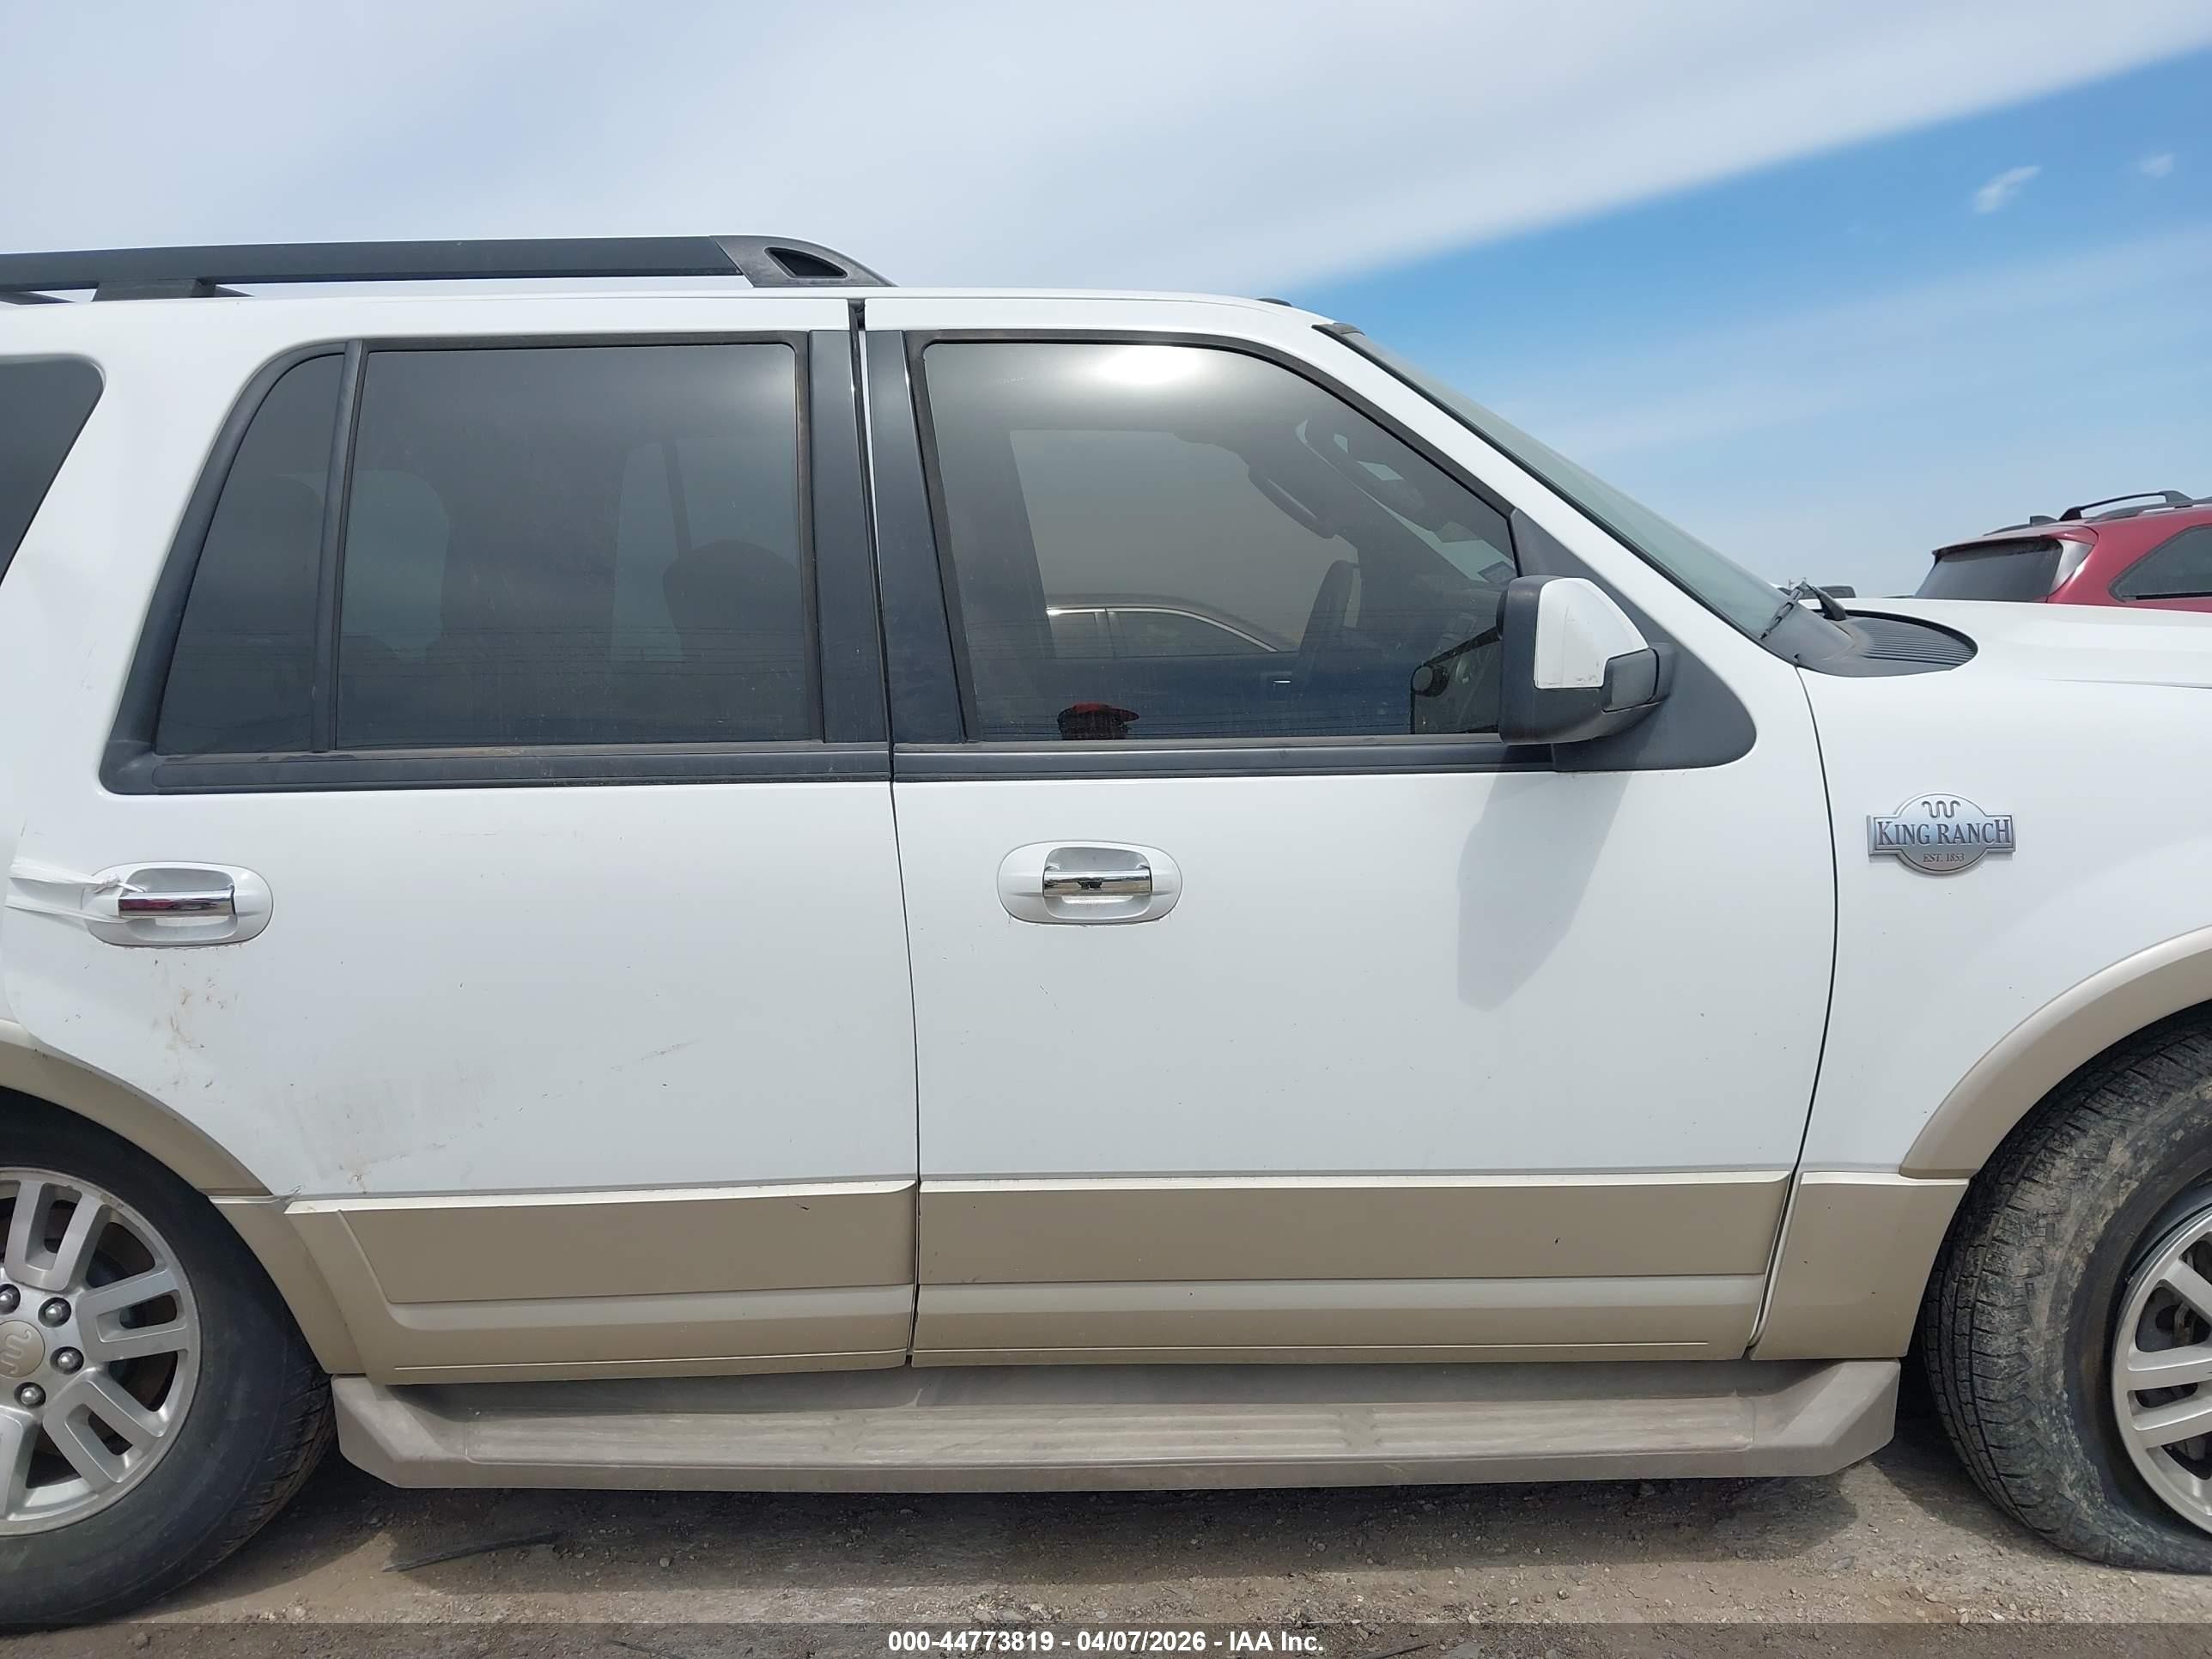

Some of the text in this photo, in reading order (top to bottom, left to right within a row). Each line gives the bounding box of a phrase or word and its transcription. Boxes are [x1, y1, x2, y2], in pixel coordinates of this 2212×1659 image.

[1877, 818, 2012, 846] KING RANCH
[1923, 853, 1965, 863] EST. 1853
